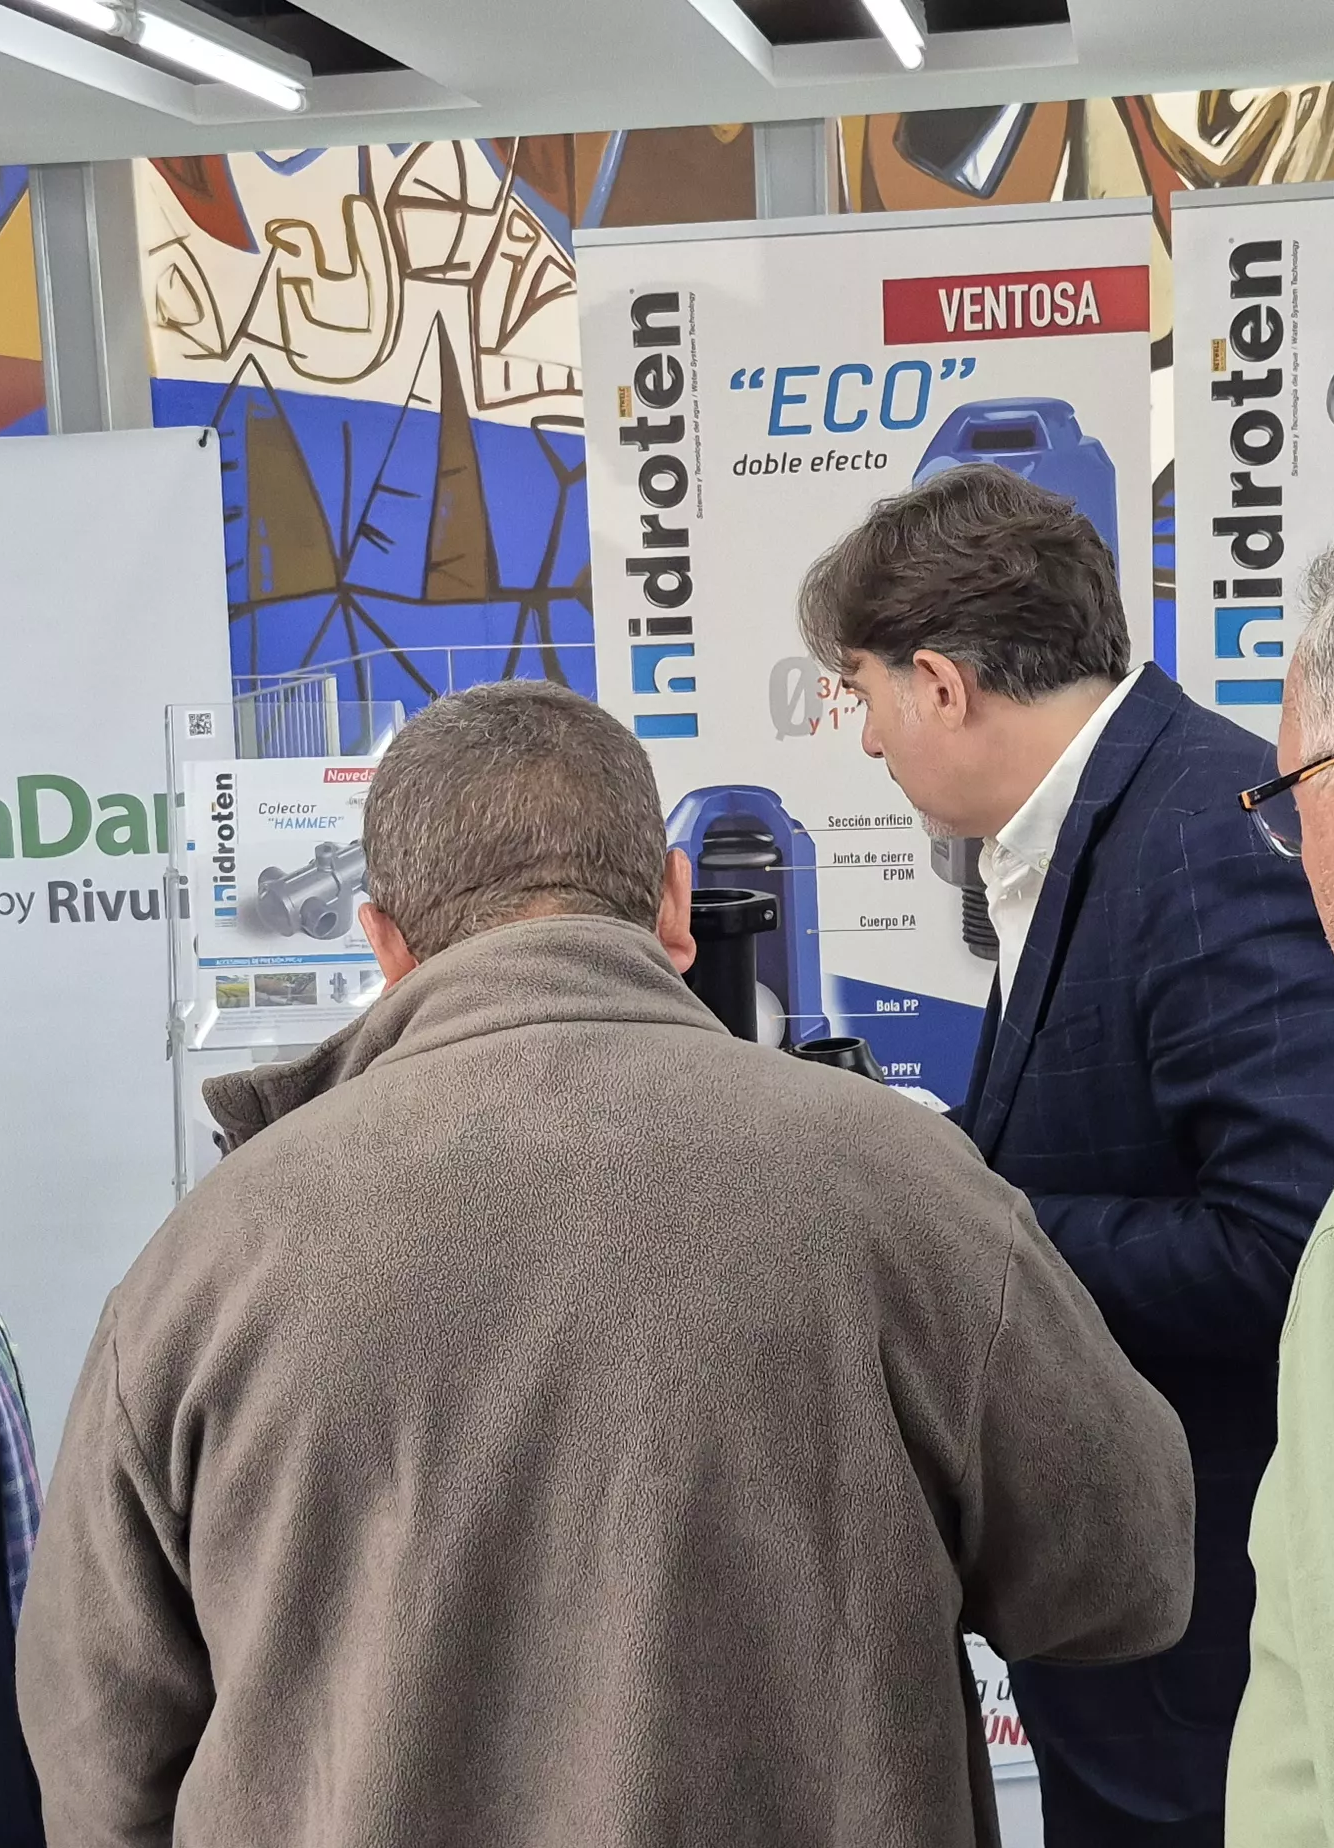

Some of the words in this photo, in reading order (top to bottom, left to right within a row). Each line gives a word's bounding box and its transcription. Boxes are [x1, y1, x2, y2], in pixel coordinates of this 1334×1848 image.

[938, 280, 1101, 332] VENTOSA
[1291, 289, 1299, 319] System
[690, 338, 698, 367] System
[729, 357, 977, 436] “ECO”
[733, 452, 803, 476] doble
[810, 449, 888, 474] efecto
[808, 717, 820, 736] y
[327, 769, 375, 782] Noveda
[258, 802, 317, 815] Colector
[827, 814, 871, 827] Sección
[873, 813, 913, 827] orificio
[832, 852, 862, 864] Junta
[864, 852, 878, 863] de
[880, 852, 914, 863] cierre
[883, 868, 915, 881] EPDM
[47, 874, 190, 923] Rivuli
[859, 916, 898, 930] Cuerpo
[902, 914, 916, 928] PA
[876, 1000, 900, 1012] Bola
[902, 999, 919, 1012] PP
[891, 1062, 921, 1076] PPFV
